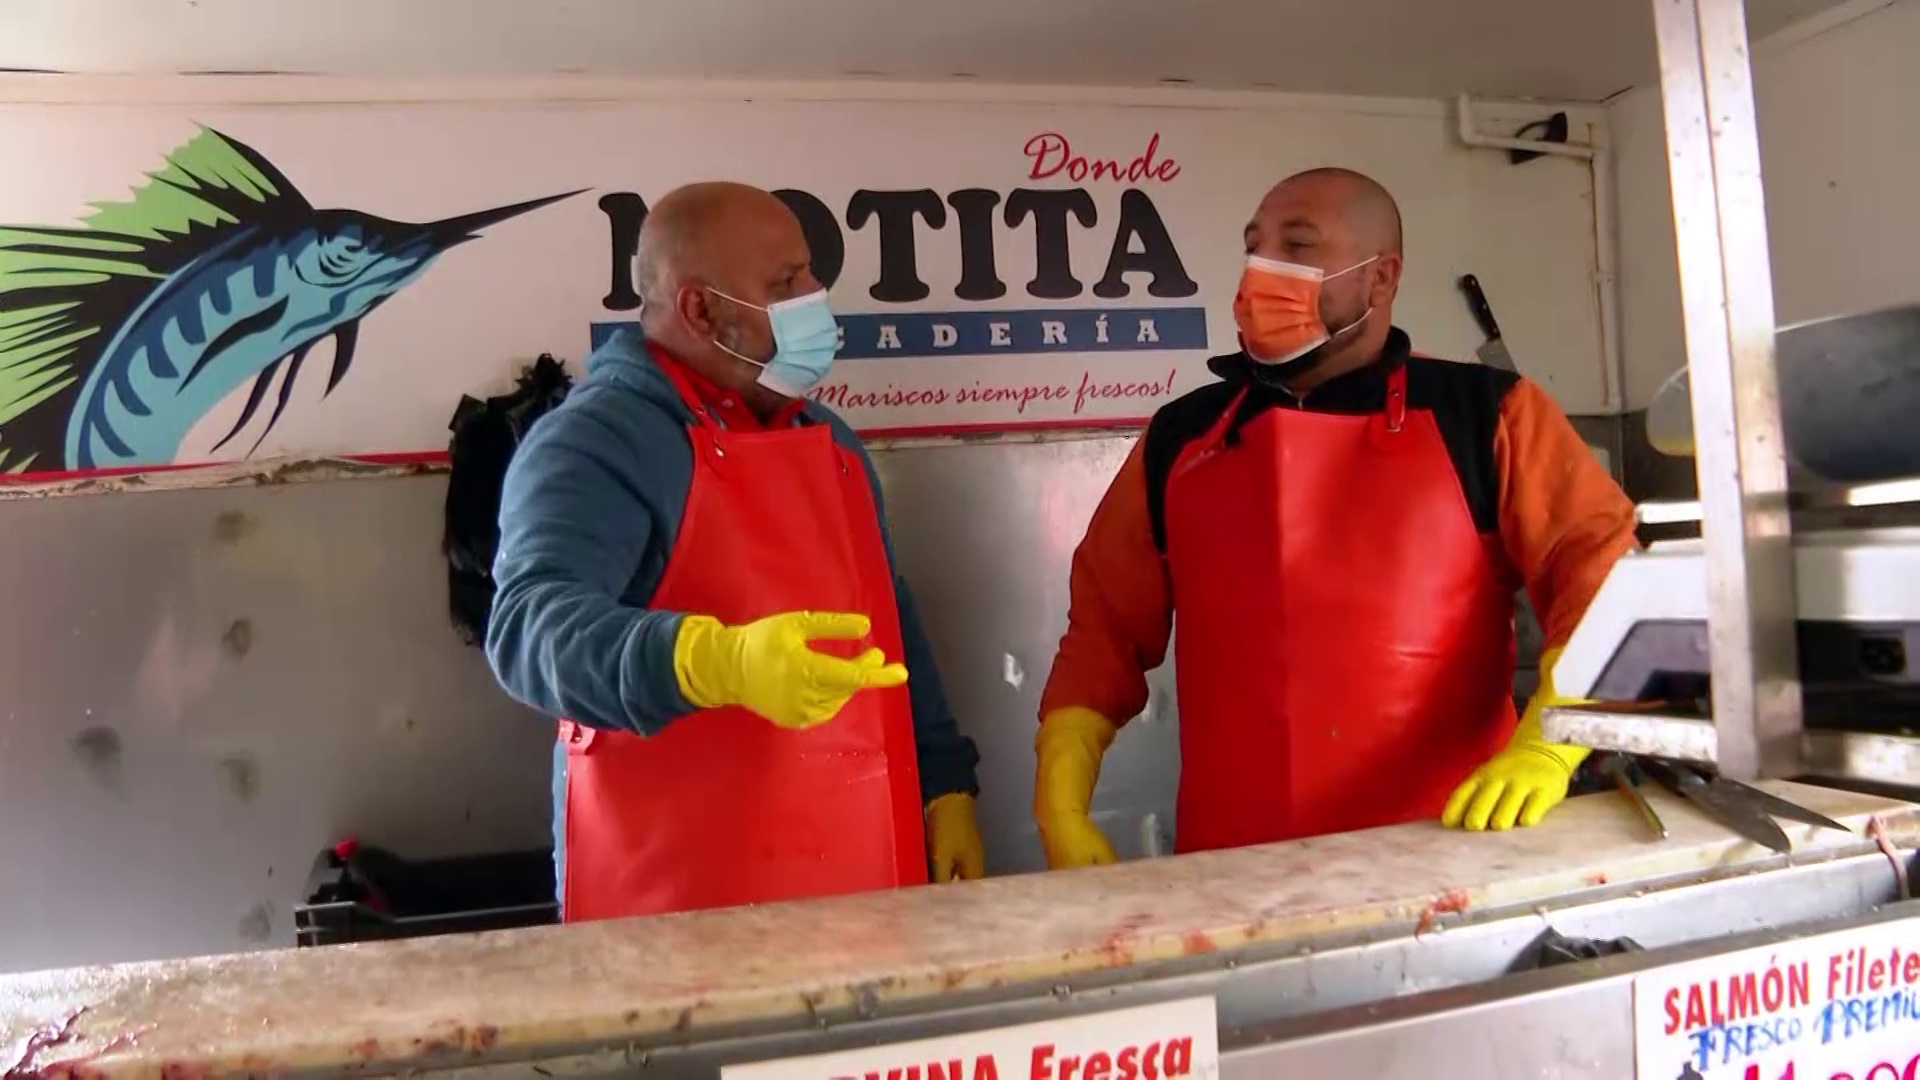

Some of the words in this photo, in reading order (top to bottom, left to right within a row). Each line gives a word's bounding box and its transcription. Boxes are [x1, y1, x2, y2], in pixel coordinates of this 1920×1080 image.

[1024, 132, 1181, 182] Donde
[812, 382, 949, 412] Mariscos
[956, 381, 1070, 413] siempre
[1074, 369, 1176, 413] frescos!
[1664, 954, 1809, 1035] SALMÓN
[1827, 947, 1920, 1000] Filete
[1688, 1016, 1802, 1071] FRESCO
